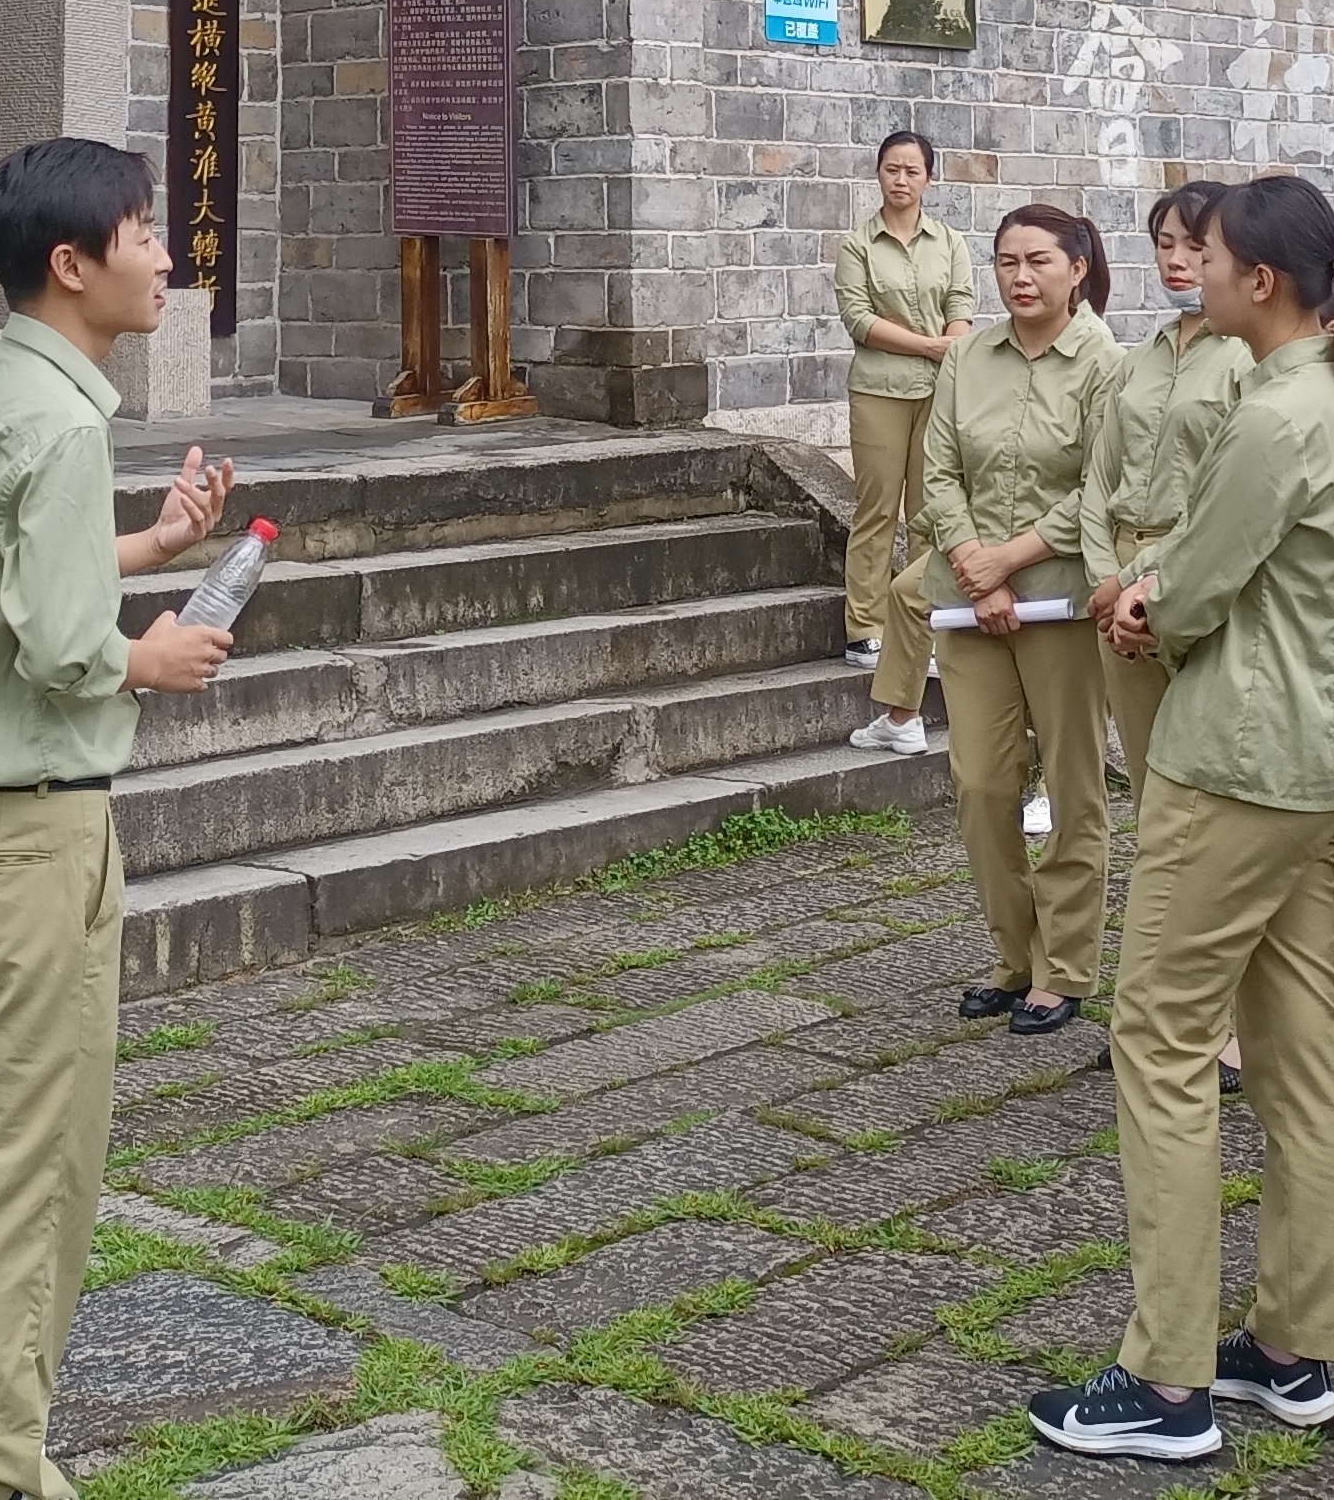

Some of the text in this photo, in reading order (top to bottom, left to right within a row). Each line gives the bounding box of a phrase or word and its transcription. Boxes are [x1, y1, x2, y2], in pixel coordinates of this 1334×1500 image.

[784, 20, 819, 40] 已覆盖
[422, 112, 472, 122] Notice to Visitors
